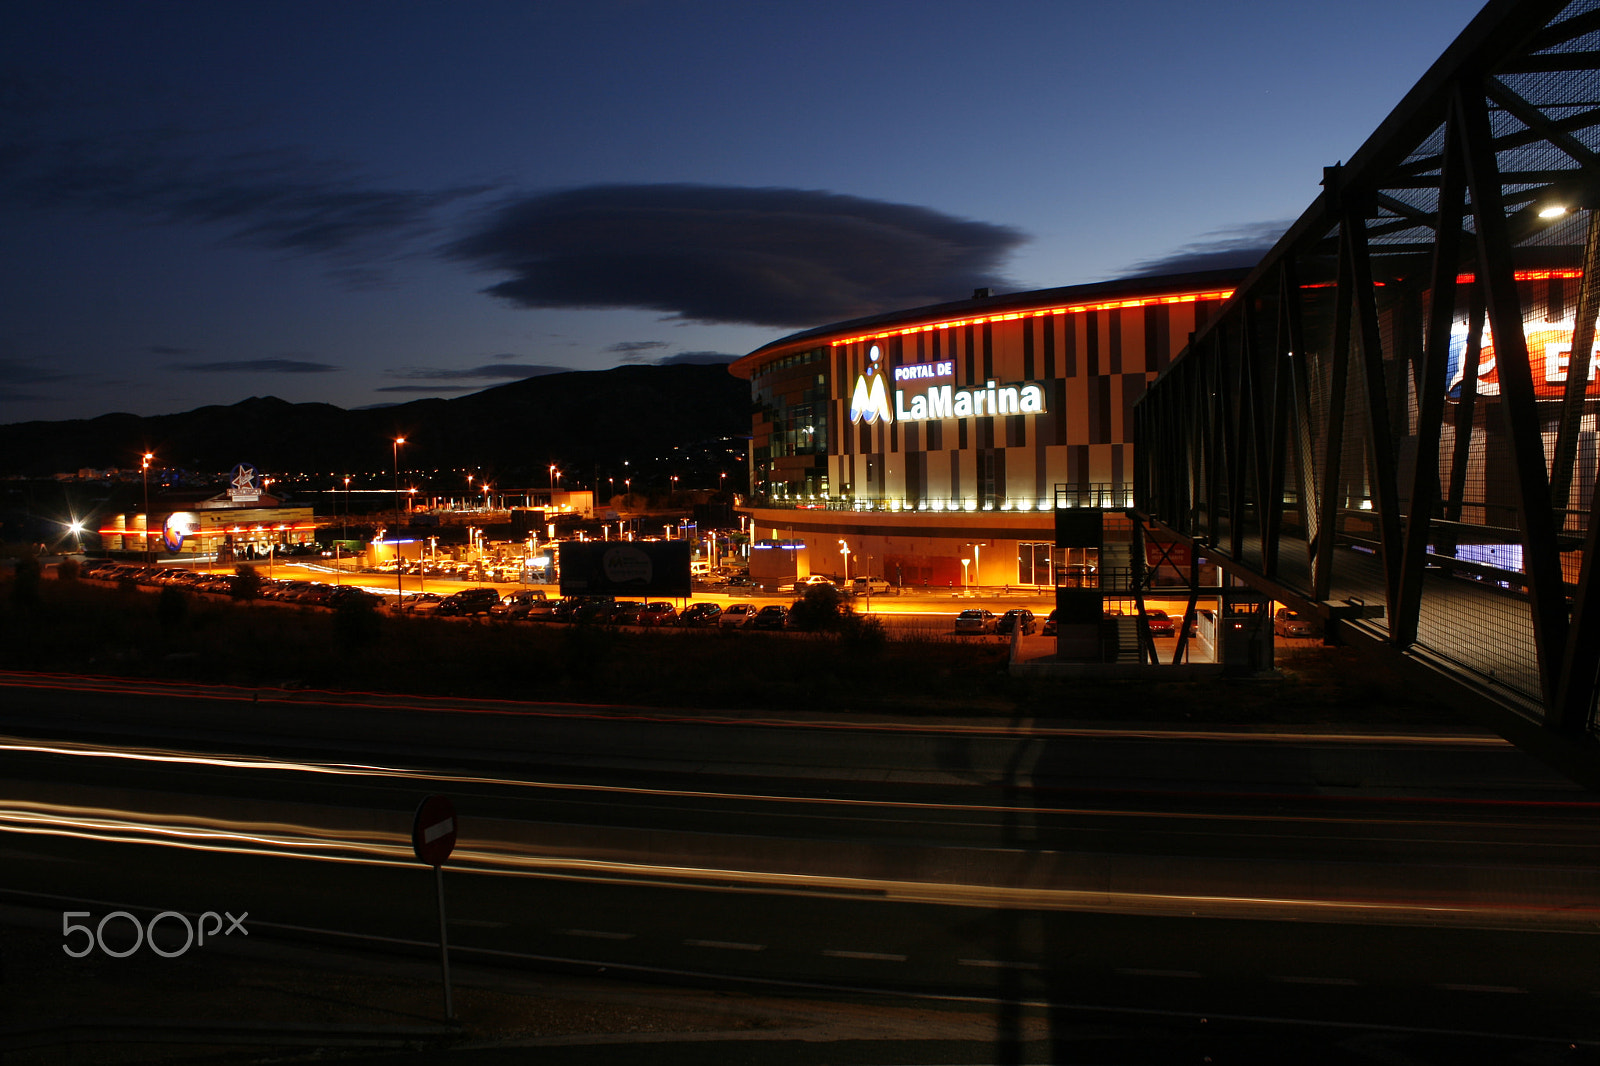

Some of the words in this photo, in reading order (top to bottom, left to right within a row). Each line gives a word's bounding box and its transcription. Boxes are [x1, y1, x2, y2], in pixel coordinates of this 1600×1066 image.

[895, 365, 935, 381] PORTAL
[937, 362, 953, 376] DE
[896, 380, 1042, 421] LaMarina
